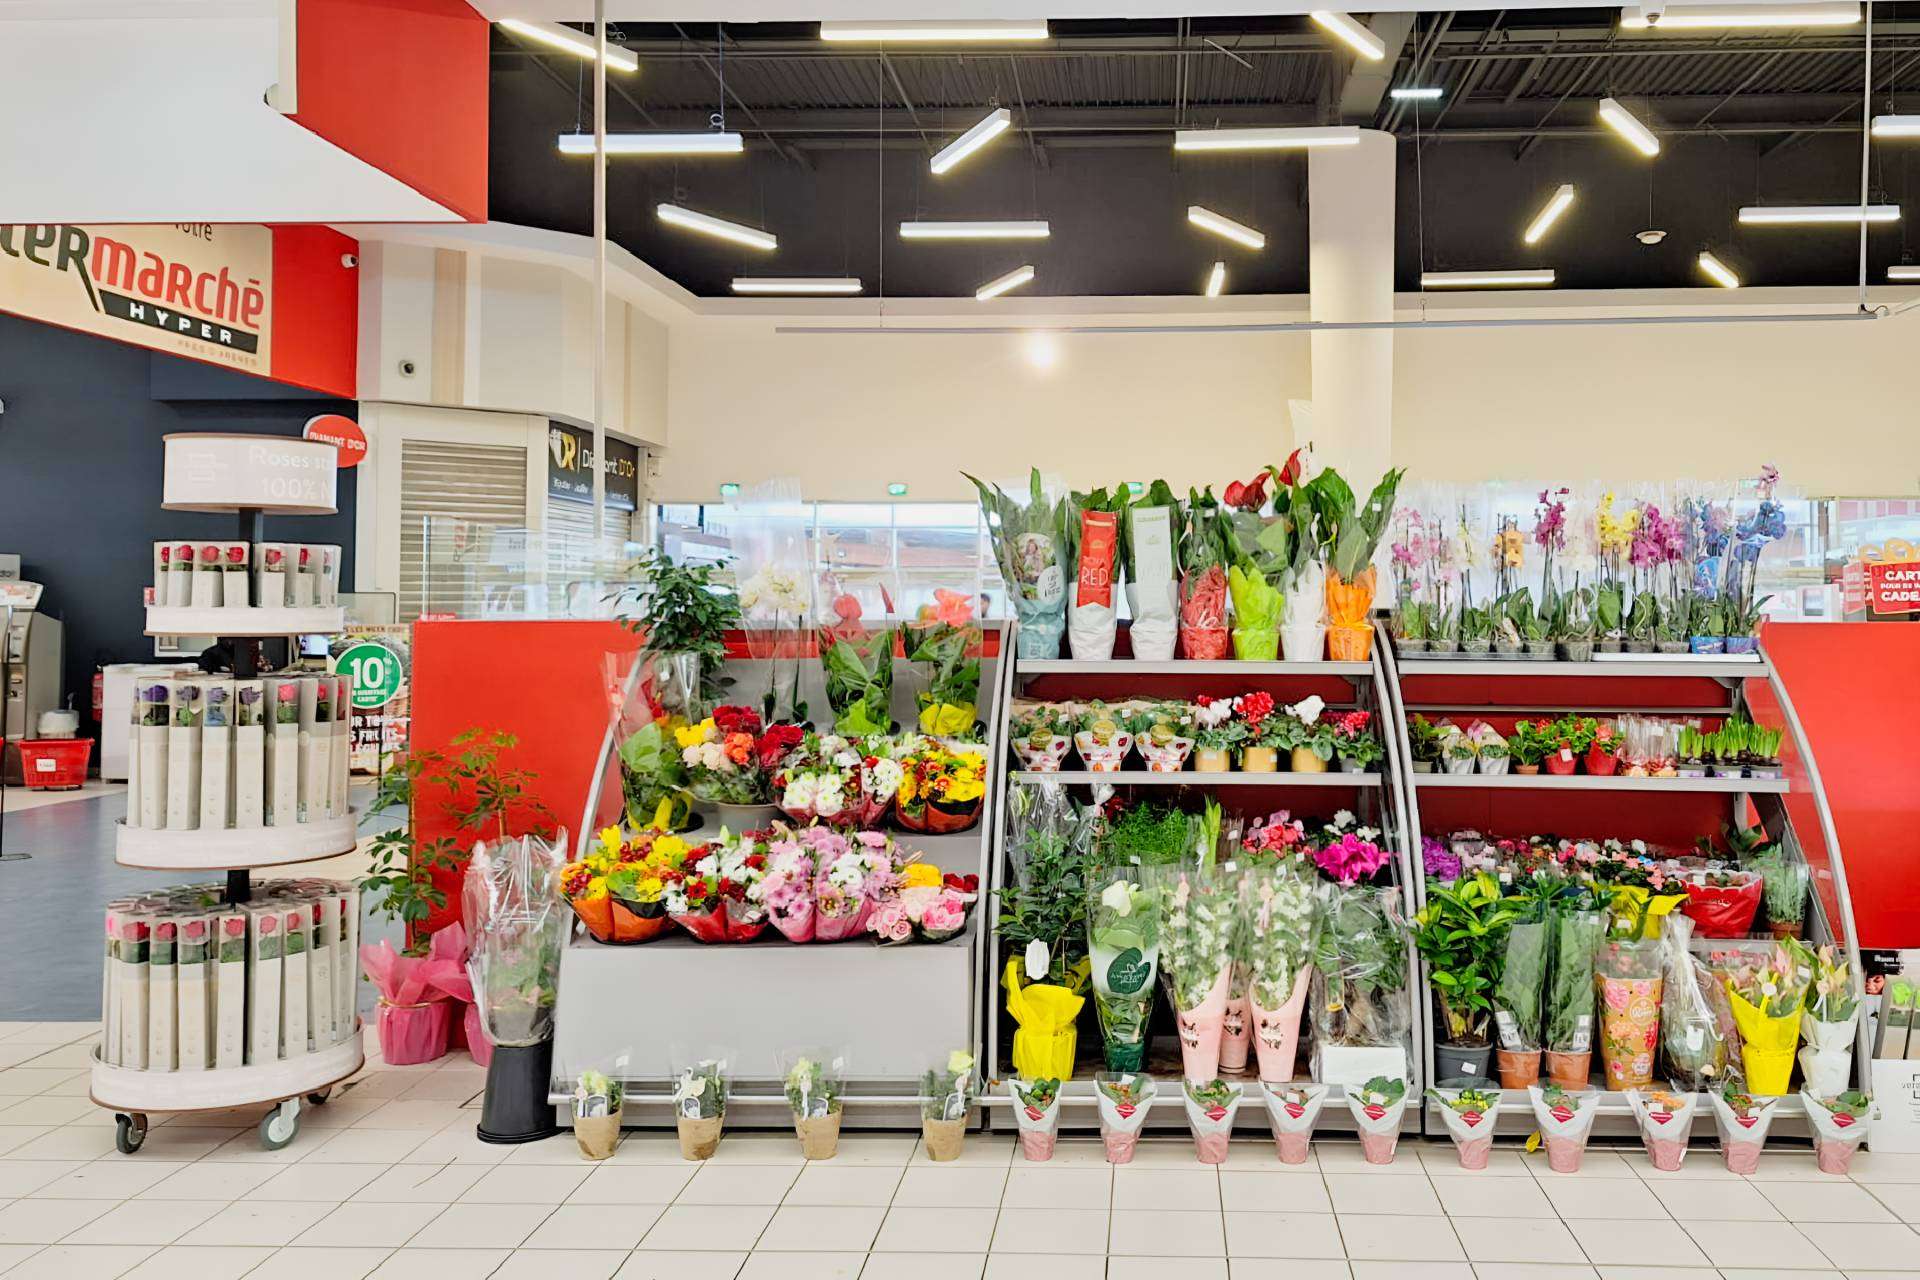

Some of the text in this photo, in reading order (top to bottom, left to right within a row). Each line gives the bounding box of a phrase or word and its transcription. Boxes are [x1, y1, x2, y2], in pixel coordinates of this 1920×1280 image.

[129, 301, 233, 345] HYPER
[249, 444, 310, 469] Roses
[1082, 567, 1109, 586] RED
